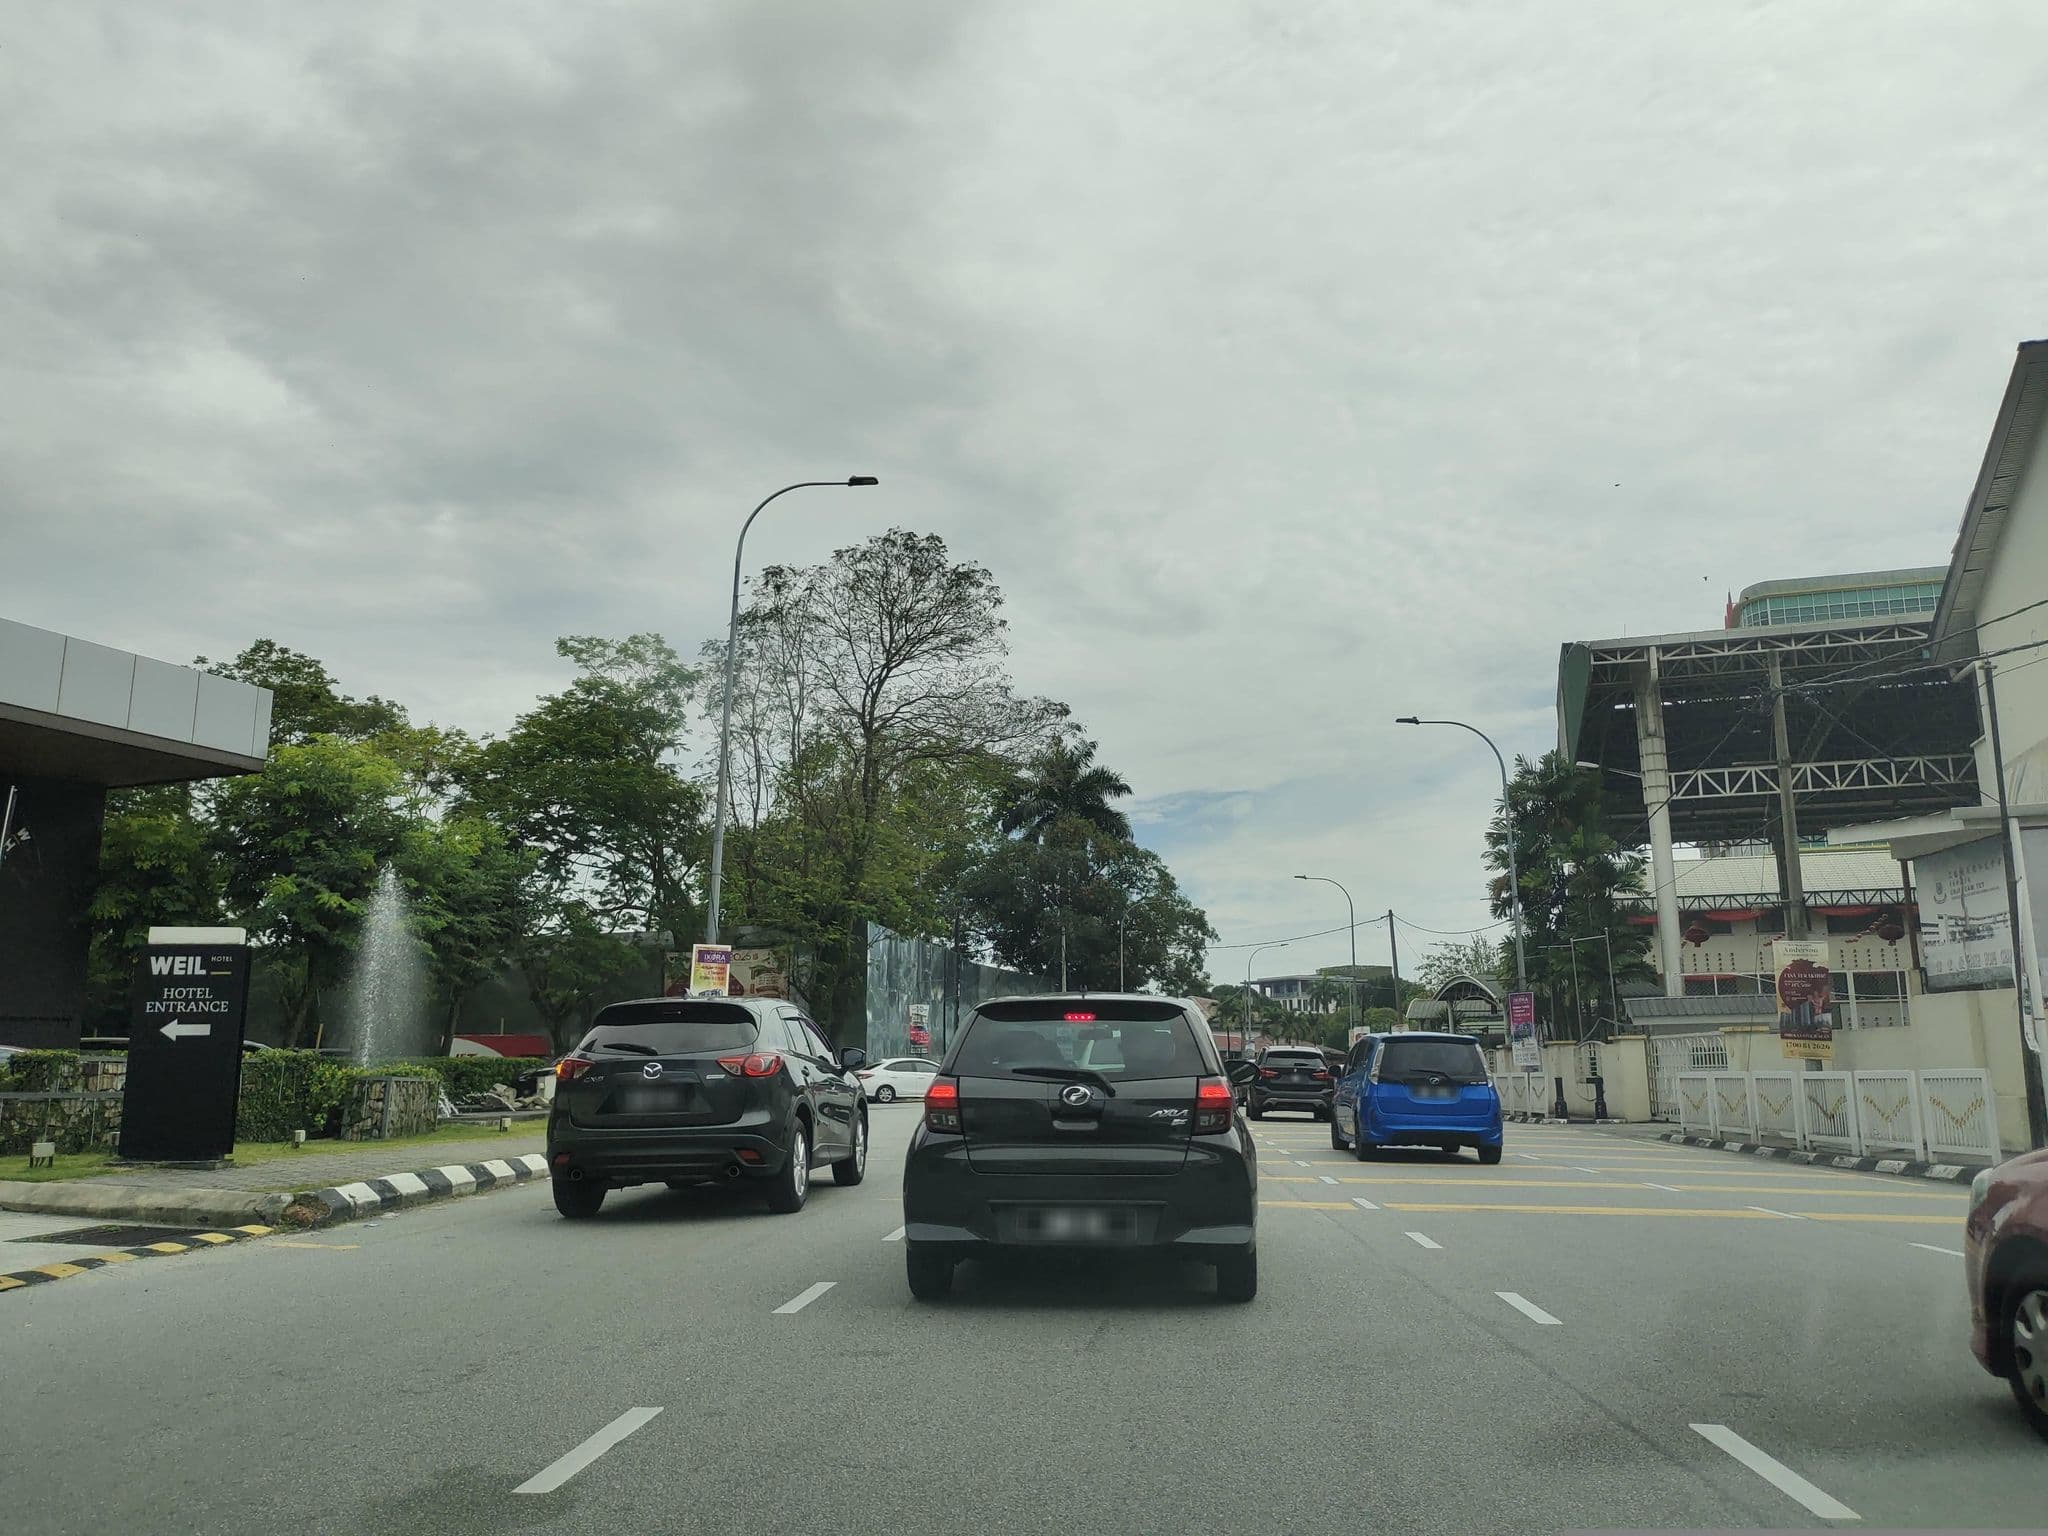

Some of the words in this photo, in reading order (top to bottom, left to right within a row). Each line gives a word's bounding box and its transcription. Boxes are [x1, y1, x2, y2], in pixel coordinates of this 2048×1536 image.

[150, 956, 207, 975] WEIL
[163, 987, 213, 999] HOTEL
[145, 1001, 229, 1013] ENTRANCE
